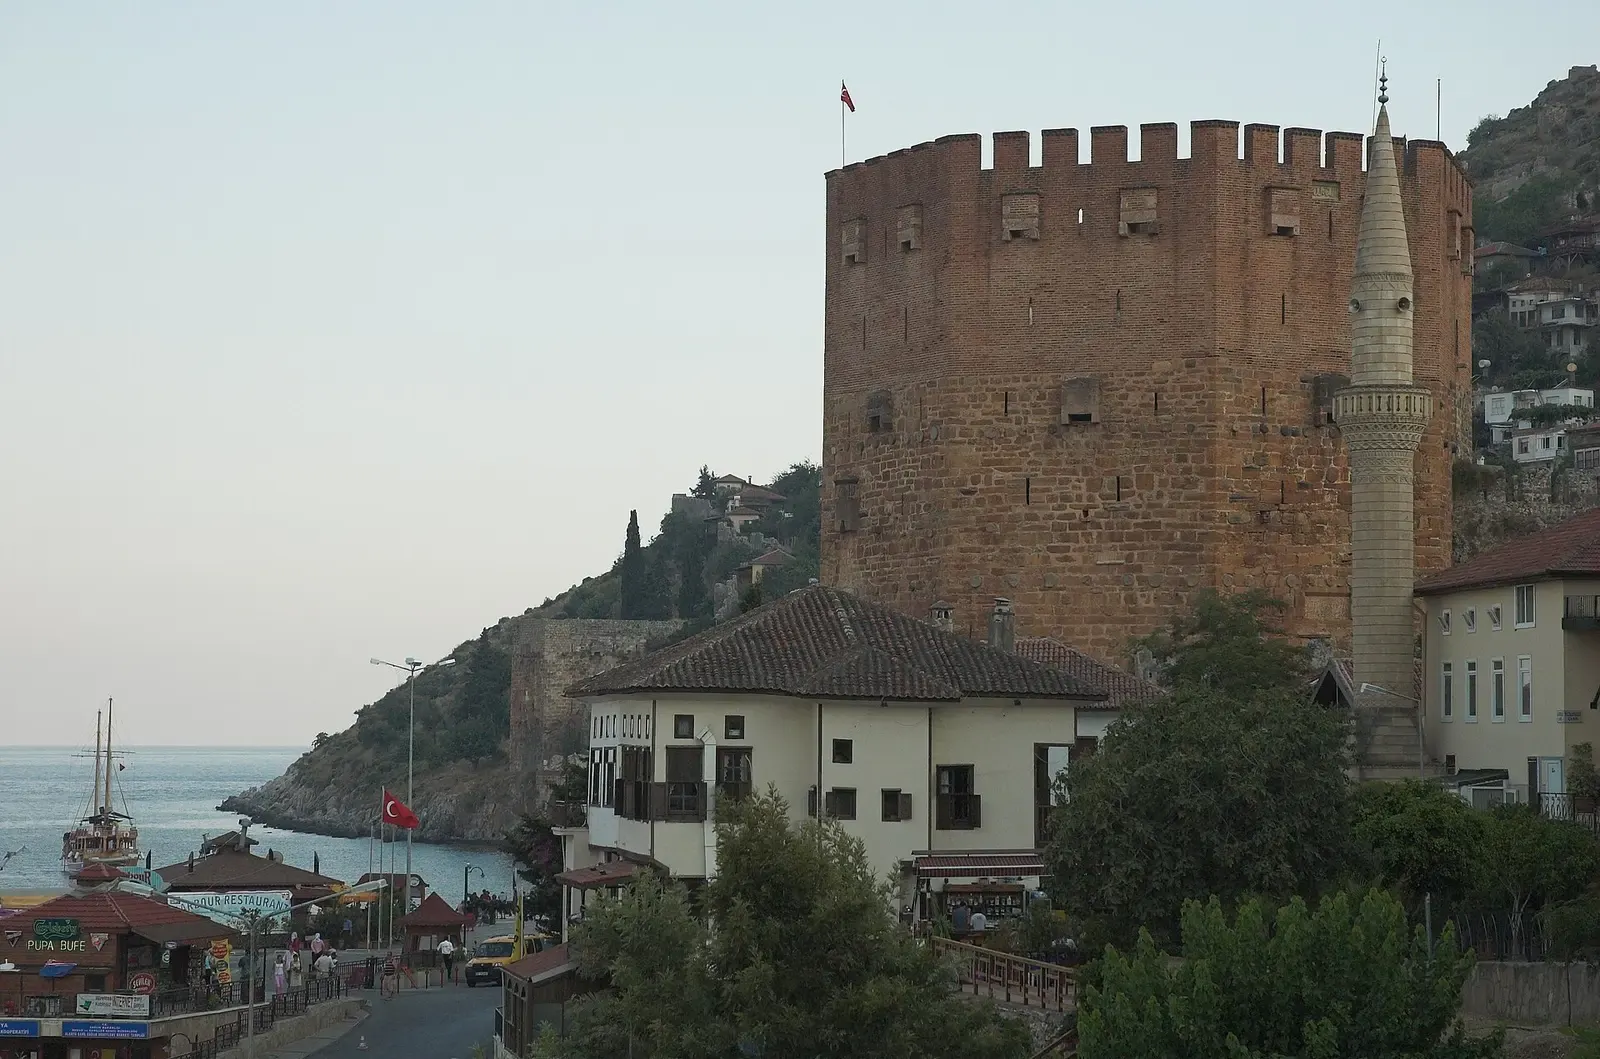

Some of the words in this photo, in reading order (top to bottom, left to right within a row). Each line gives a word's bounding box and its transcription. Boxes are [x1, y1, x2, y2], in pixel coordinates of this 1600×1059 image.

[180, 896, 221, 911] ARBOUR
[27, 940, 54, 951] PUPA
[60, 940, 86, 951] BUFE
